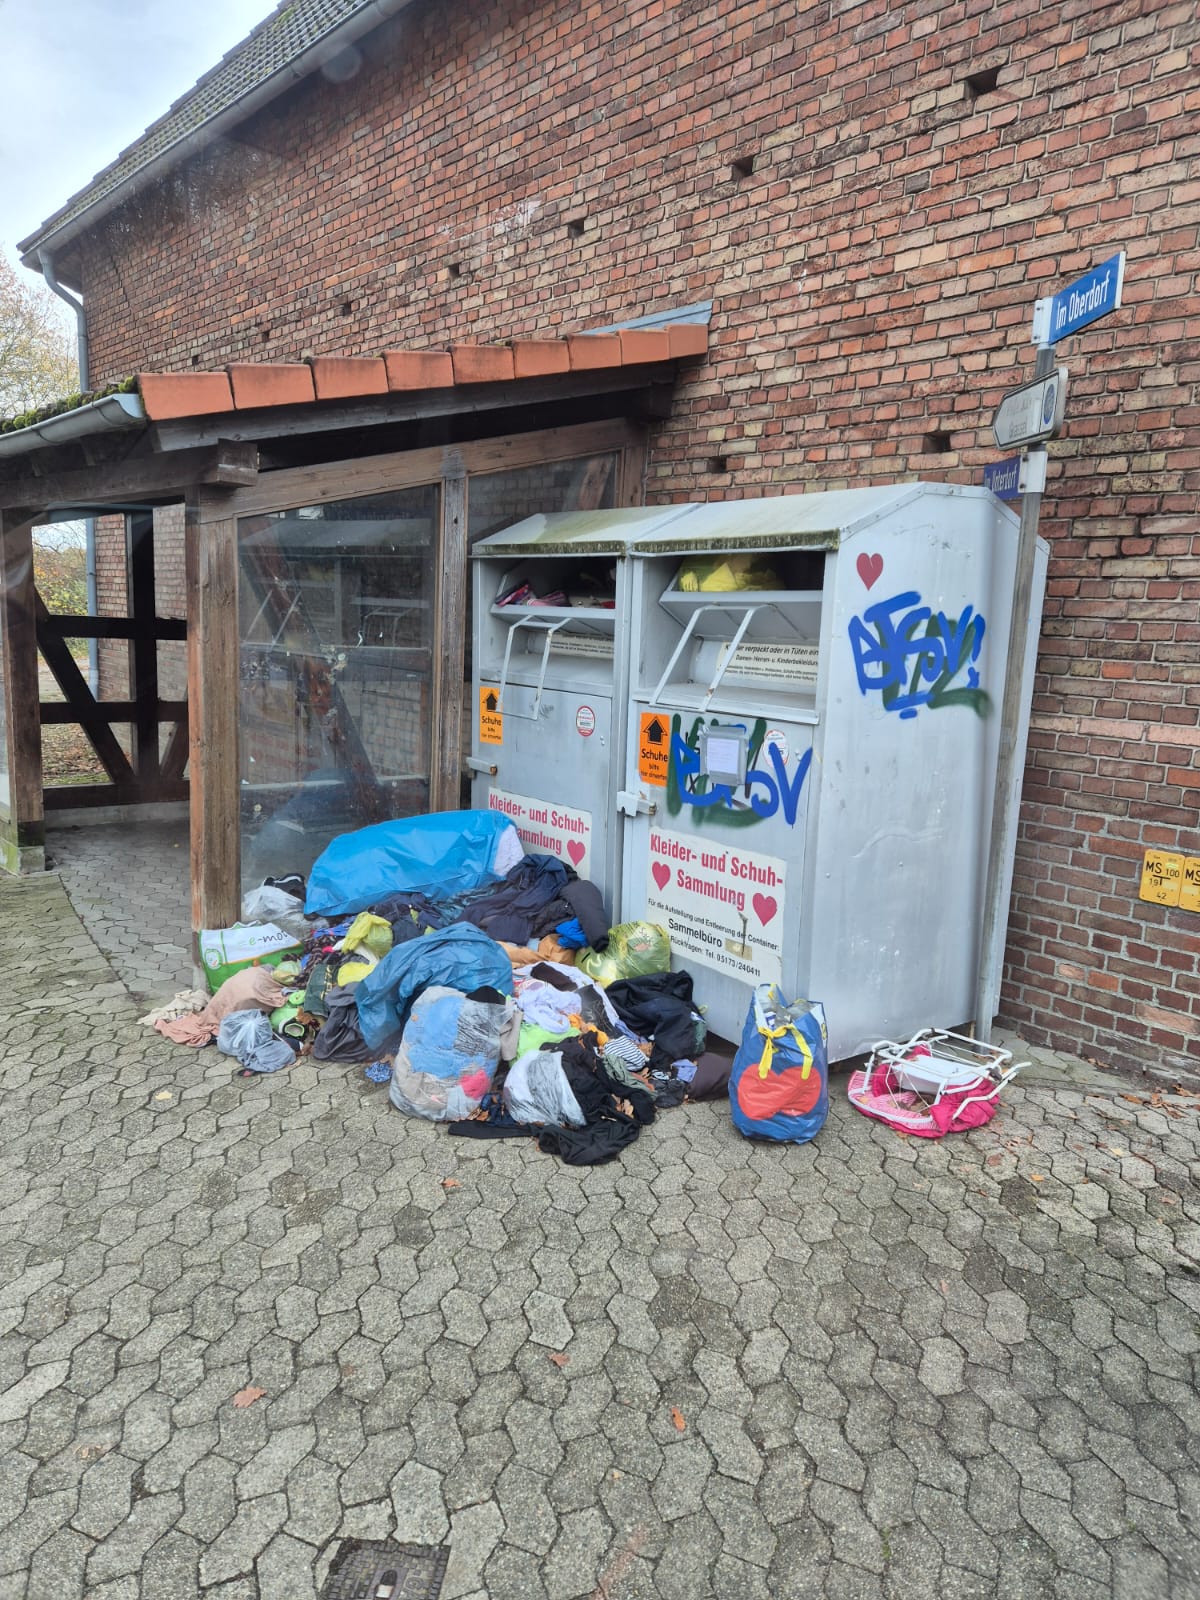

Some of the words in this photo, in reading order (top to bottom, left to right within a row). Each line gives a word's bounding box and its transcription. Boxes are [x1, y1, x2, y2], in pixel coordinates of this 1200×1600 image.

[1055, 301, 1067, 331] Im
[1068, 270, 1110, 322] Oberdorf
[744, 645, 769, 654] verpackt
[770, 646, 783, 654] oder
[791, 647, 808, 655] Tüten
[481, 715, 502, 726] Schuhe
[641, 748, 669, 762] Schuhe
[489, 793, 526, 816] Kleider-
[529, 808, 548, 824] und
[551, 810, 590, 834] Schuh-
[517, 827, 562, 855] ammlung
[650, 833, 697, 862] Kleider-
[701, 852, 726, 872] und
[730, 857, 783, 887] Schuh-
[1145, 861, 1163, 874] MS
[1166, 868, 1180, 878] 100
[677, 869, 746, 911] Sammlung
[1156, 892, 1167, 900] 42
[648, 898, 656, 906] Für
[665, 903, 694, 922] Aufstellung
[694, 912, 705, 923] und
[705, 918, 736, 938] Entleerung
[668, 918, 723, 948] Sammelbüro
[705, 948, 716, 960] Tel.
